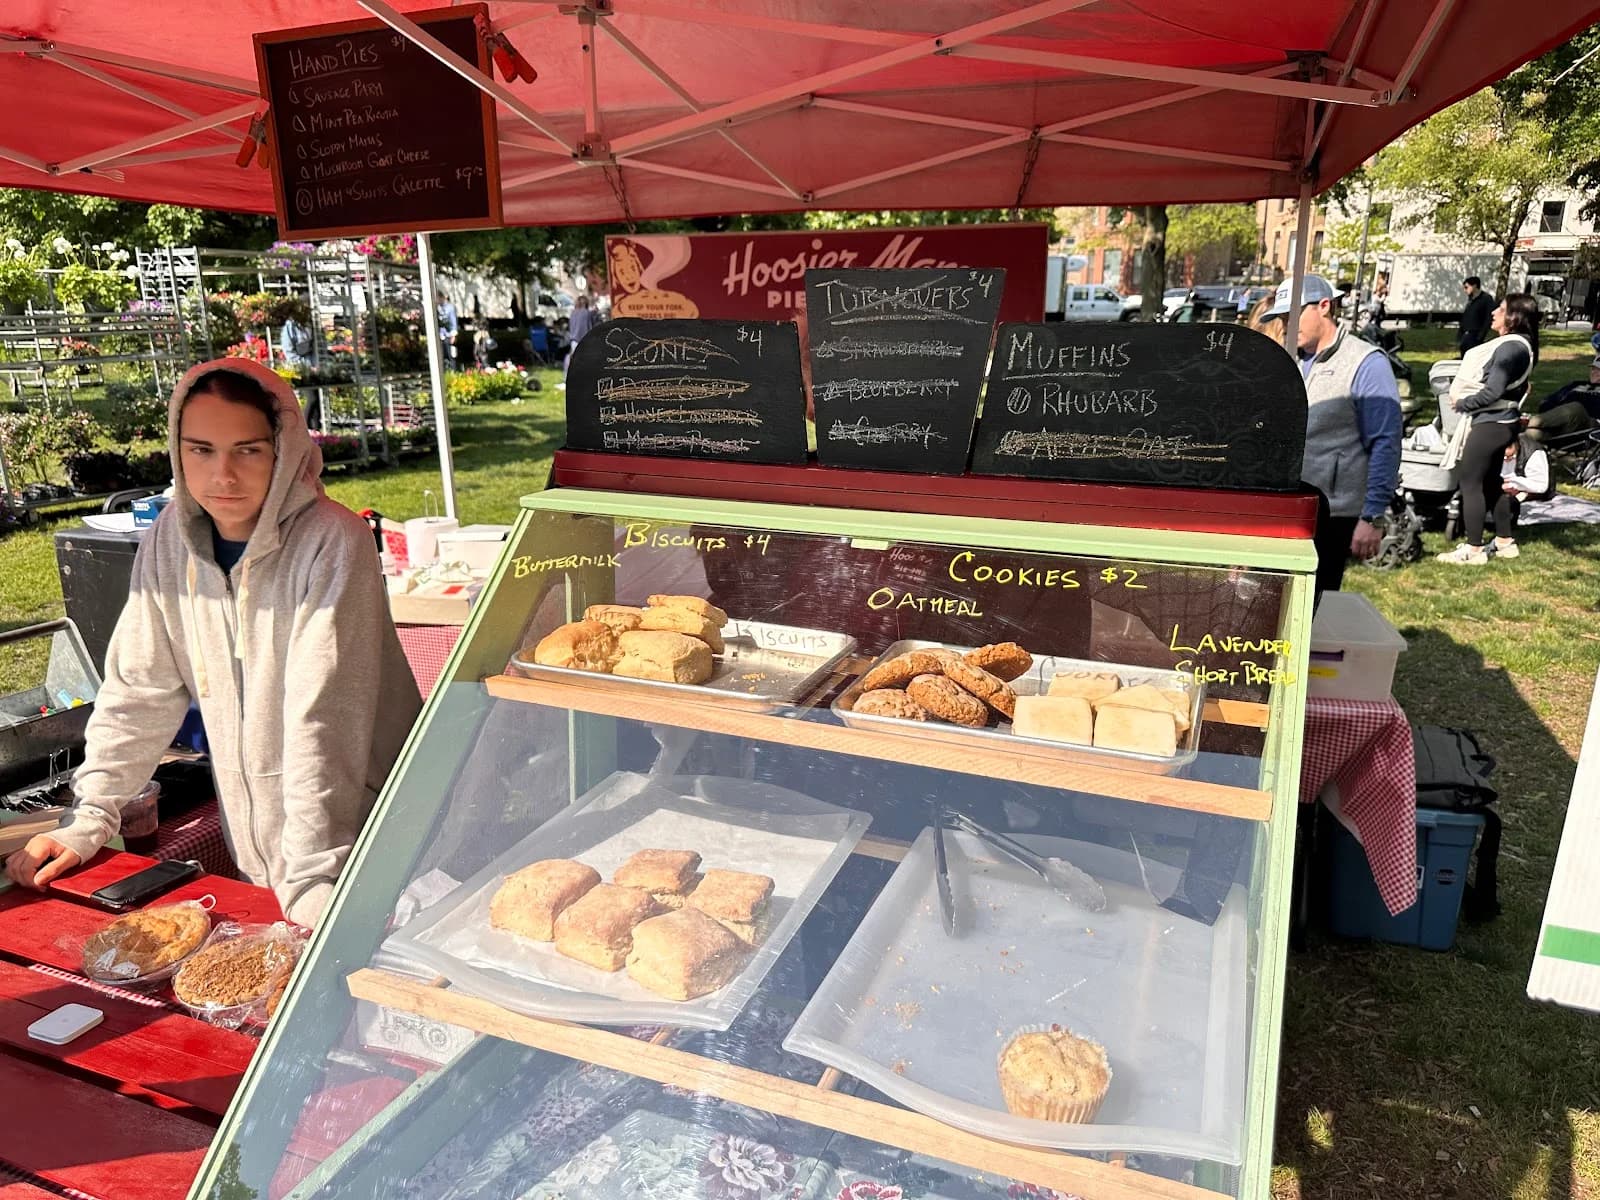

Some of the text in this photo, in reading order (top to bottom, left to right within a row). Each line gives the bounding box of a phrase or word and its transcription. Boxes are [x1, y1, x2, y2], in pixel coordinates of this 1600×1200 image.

[289, 39, 379, 78] HAND PIES
[316, 185, 343, 210] HAM
[736, 325, 763, 358] $4
[1007, 330, 1235, 371] MUFFINS $4
[1035, 382, 1159, 417] RHUBARB
[624, 523, 771, 555] BISCUITS $4
[512, 552, 622, 579] BUTTERMILK
[948, 551, 1148, 589] COOKIES $2
[867, 587, 983, 618] OATMEAL
[1169, 623, 1293, 656] LAVENDER
